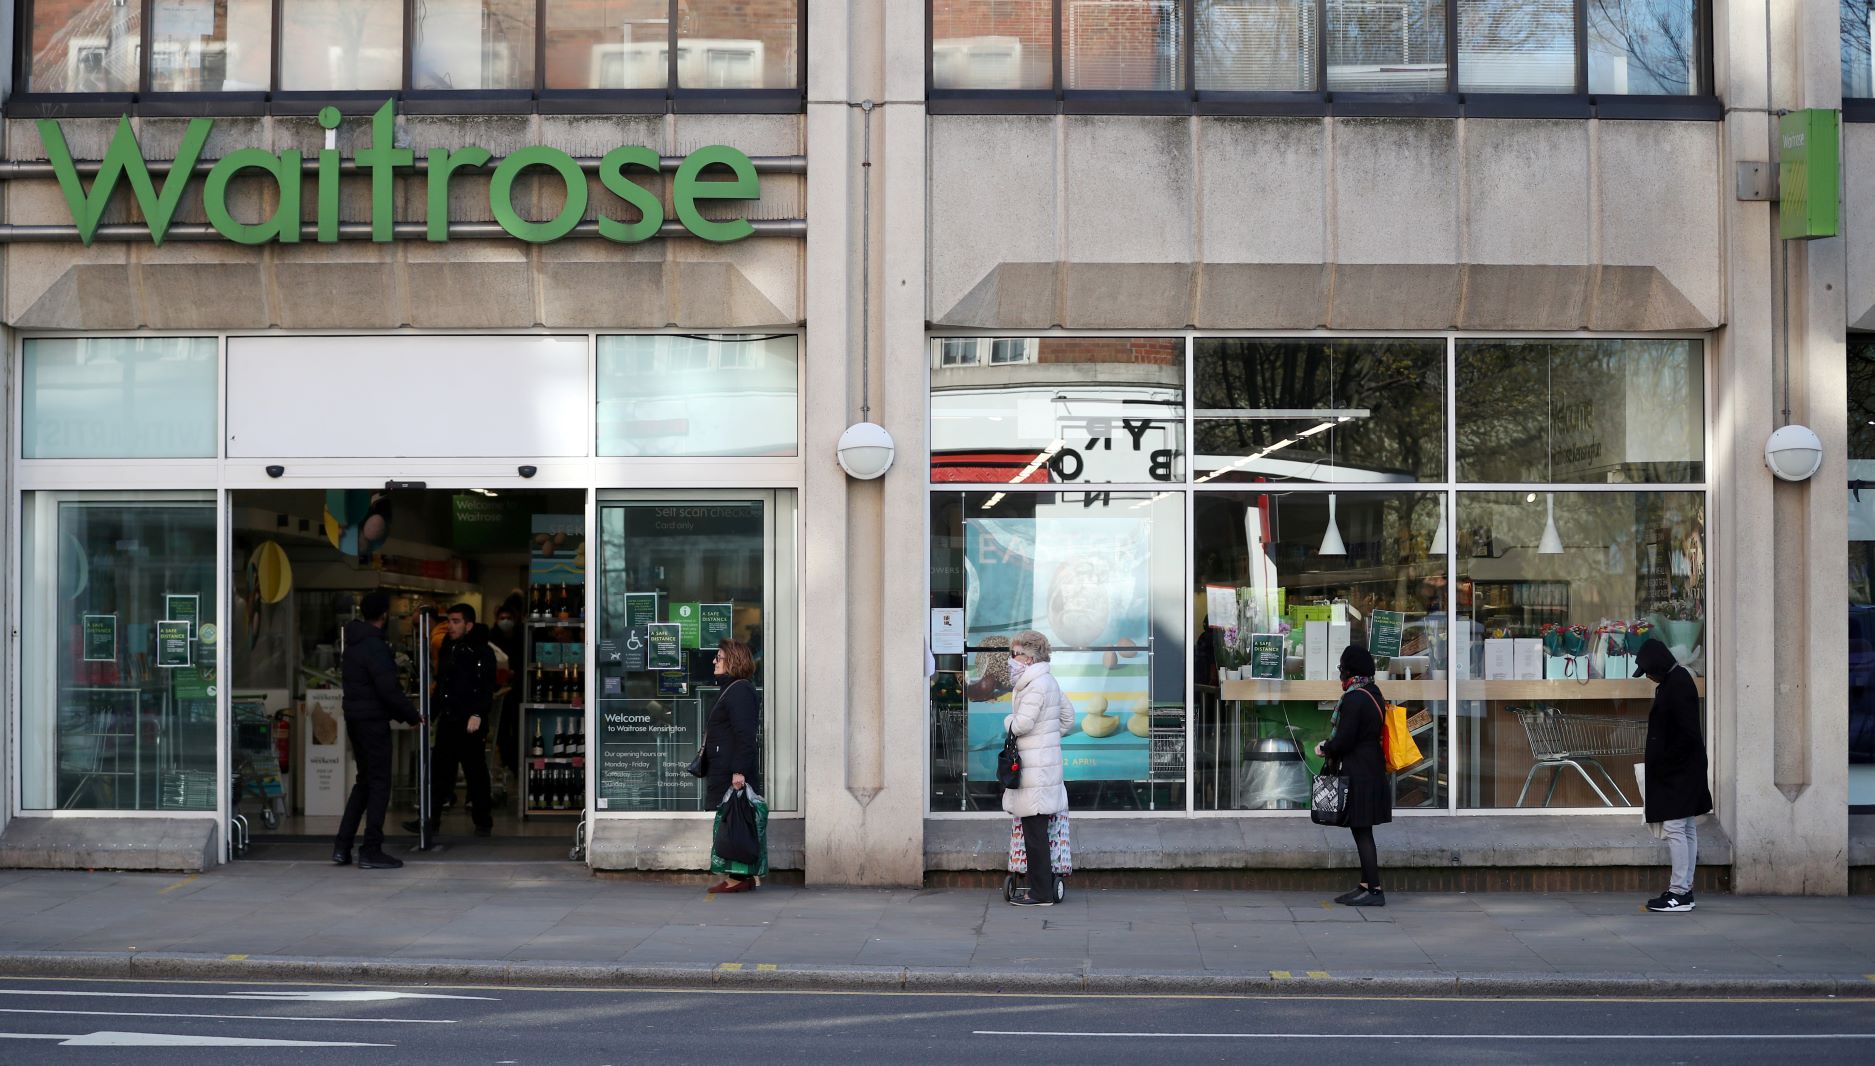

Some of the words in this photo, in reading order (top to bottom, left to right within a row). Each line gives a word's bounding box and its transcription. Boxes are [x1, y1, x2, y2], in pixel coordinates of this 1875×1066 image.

[37, 98, 761, 248] Waitrose
[604, 713, 651, 723] Welcome
[616, 724, 647, 732] Waitrose
[648, 725, 686, 733] Kensington
[616, 751, 639, 760] opening
[604, 761, 628, 769] Monday
[632, 761, 650, 769] Friday
